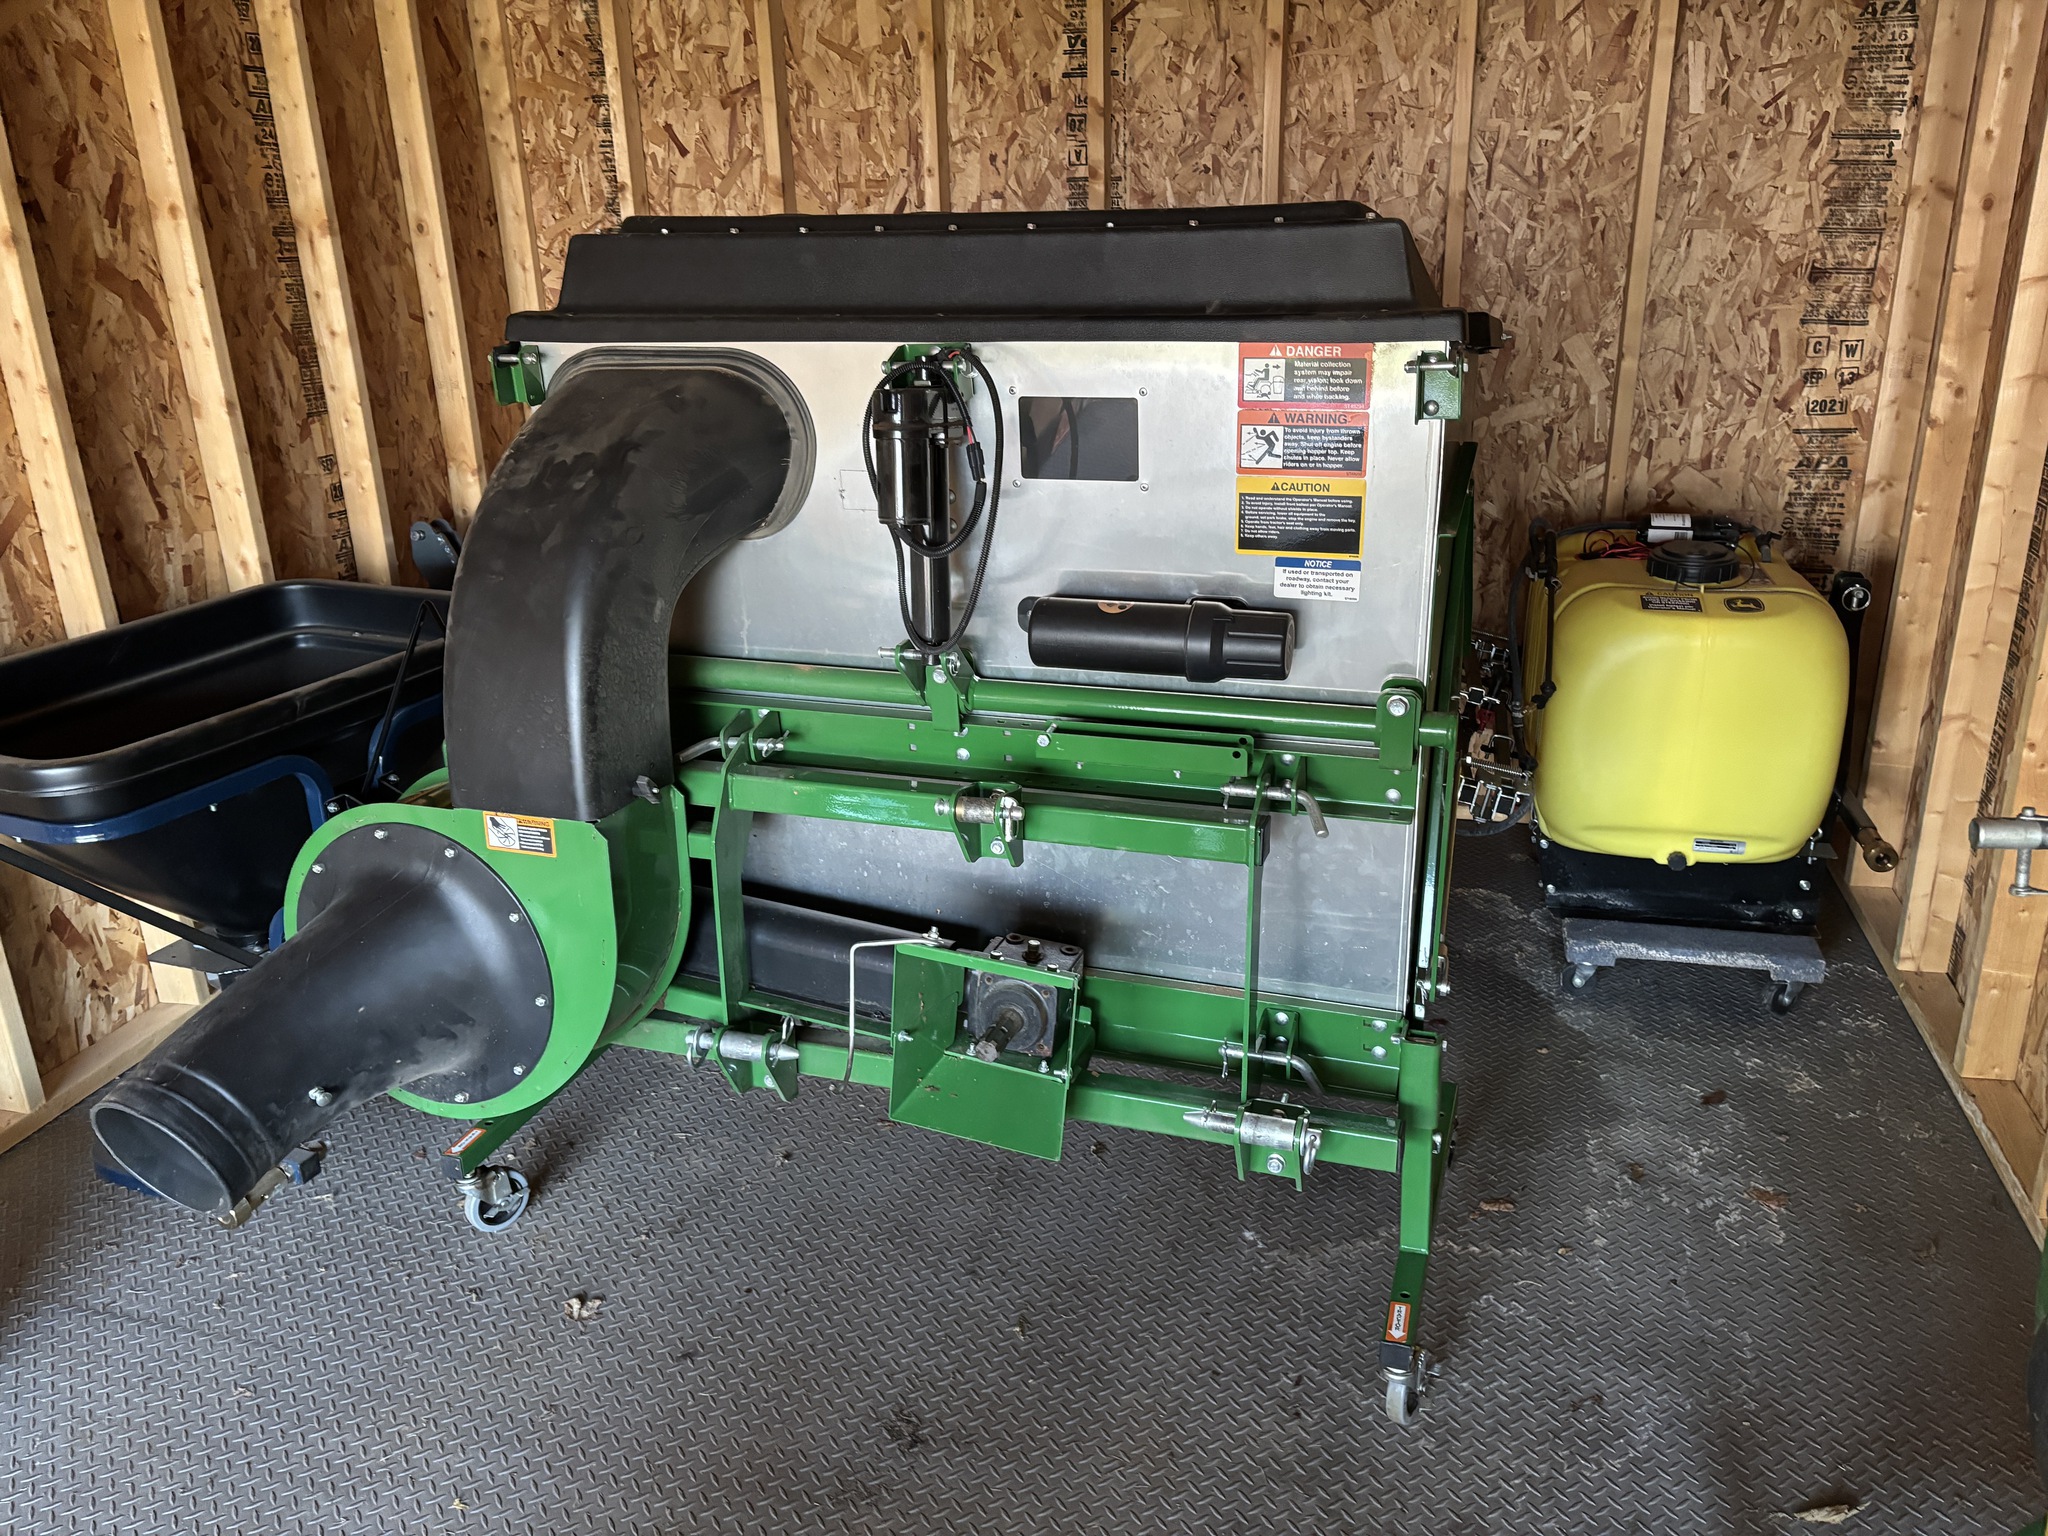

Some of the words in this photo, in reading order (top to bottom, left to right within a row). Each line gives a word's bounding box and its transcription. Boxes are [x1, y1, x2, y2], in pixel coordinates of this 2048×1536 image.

[1859, 0, 1916, 17] APA
[1074, 149, 1082, 162] A
[1286, 346, 1342, 357] DANGER
[1813, 341, 1822, 354] C
[1845, 344, 1858, 358] W
[1803, 371, 1824, 384] SEP
[1838, 371, 1855, 385] 13
[1810, 399, 1845, 412] 2021
[1284, 413, 1347, 424] WARNING
[1795, 456, 1848, 468] APA
[1280, 482, 1330, 492] CAUTION
[1304, 560, 1332, 568] NOTICE
